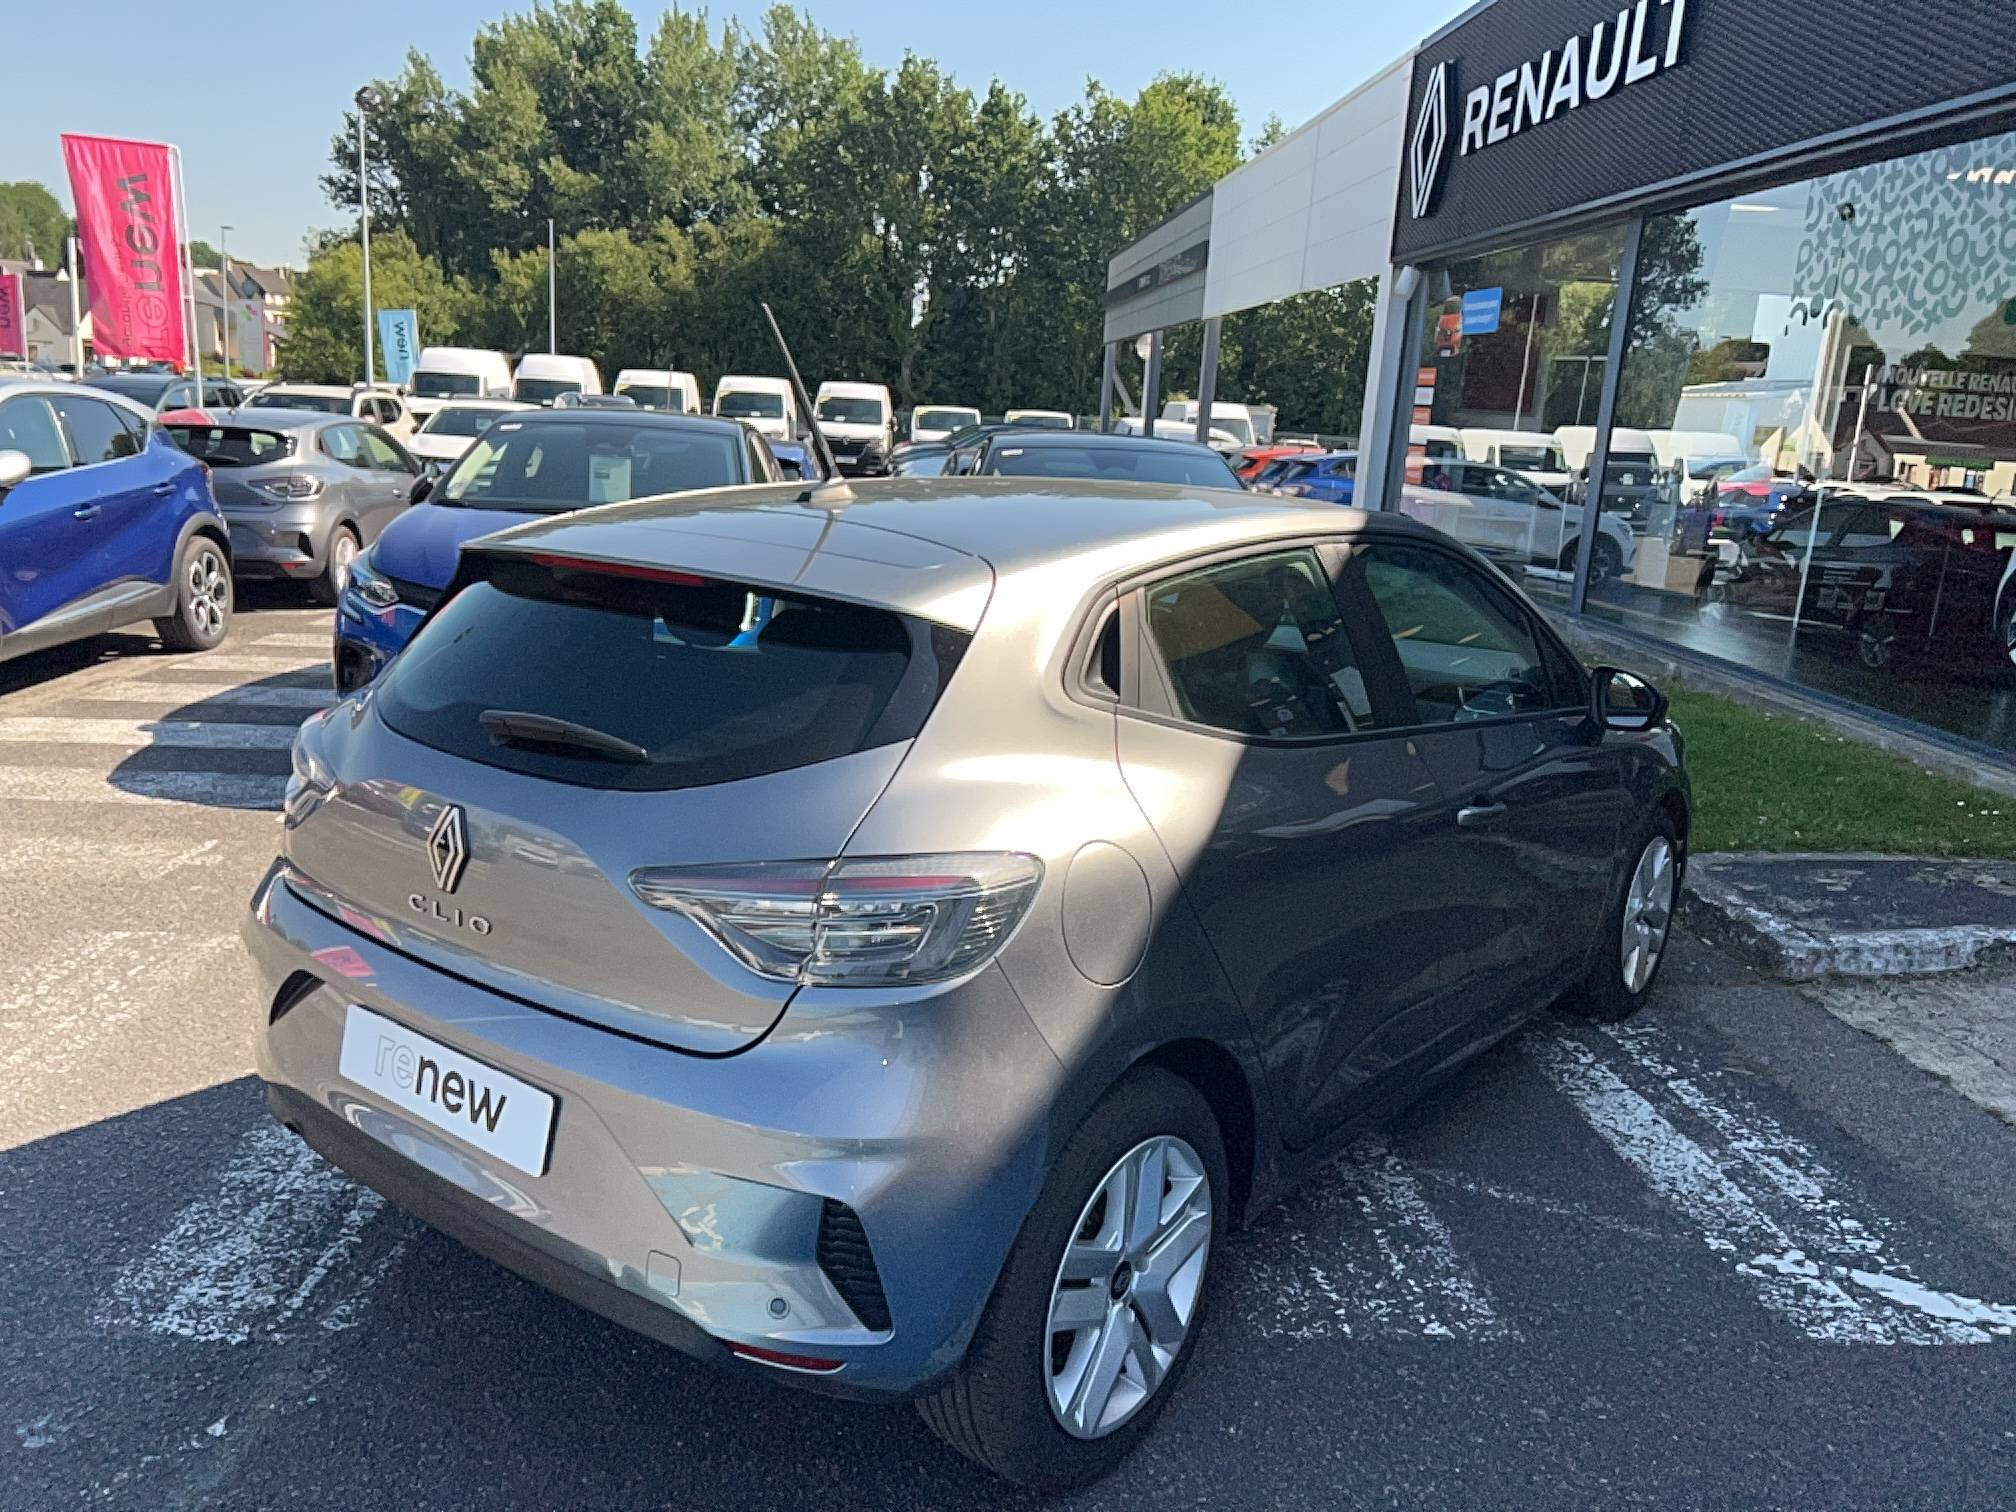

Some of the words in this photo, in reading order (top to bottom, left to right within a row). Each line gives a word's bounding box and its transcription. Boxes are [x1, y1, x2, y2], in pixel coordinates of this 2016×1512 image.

[1460, 0, 1686, 157] RENAULT
[1877, 386, 1936, 415] LOVE
[1937, 392, 2016, 421] REDESI
[408, 893, 493, 936] CLIO
[375, 1034, 508, 1133] renew
